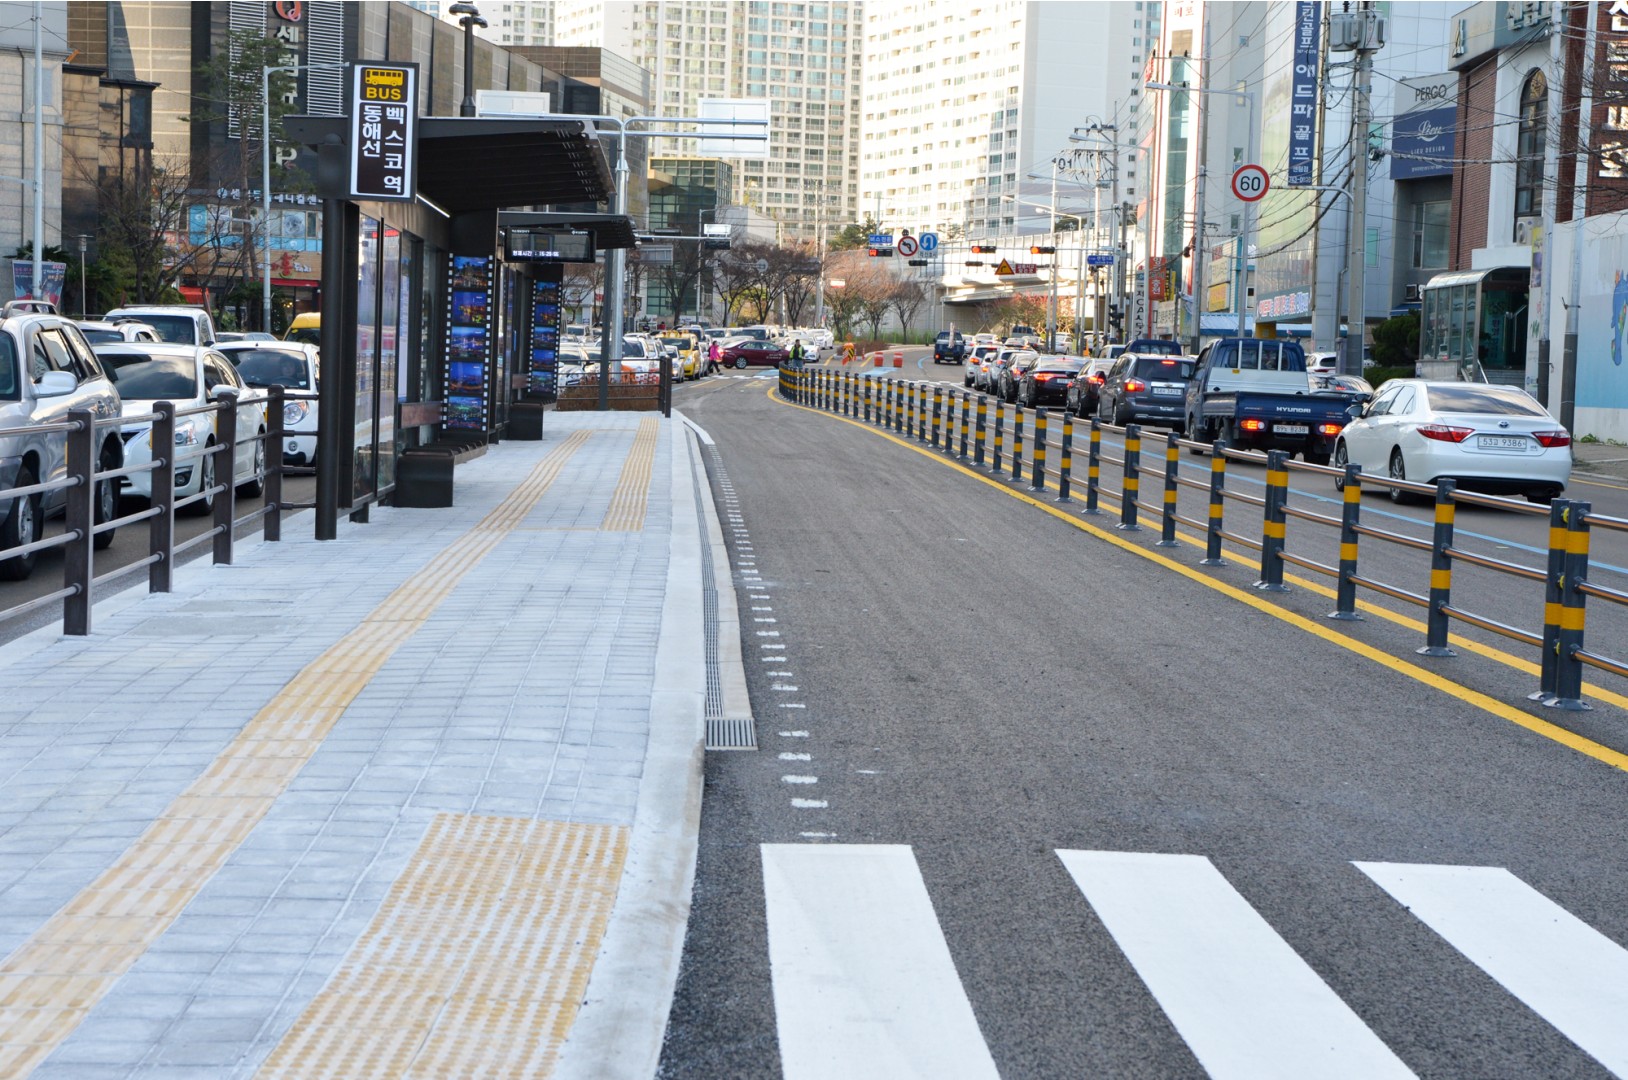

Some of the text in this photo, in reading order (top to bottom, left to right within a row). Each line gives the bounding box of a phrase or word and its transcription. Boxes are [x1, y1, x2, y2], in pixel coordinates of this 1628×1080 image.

[366, 86, 402, 101] BUS
[1415, 84, 1447, 102] PERGO
[362, 105, 382, 158] 동해선
[275, 146, 298, 167] P
[383, 107, 405, 193] 벡스코역
[1425, 145, 1446, 154] DESIGN
[1240, 175, 1261, 192] 60
[1276, 406, 1311, 414] HYUNDAI
[1502, 438, 1522, 447] 9386
